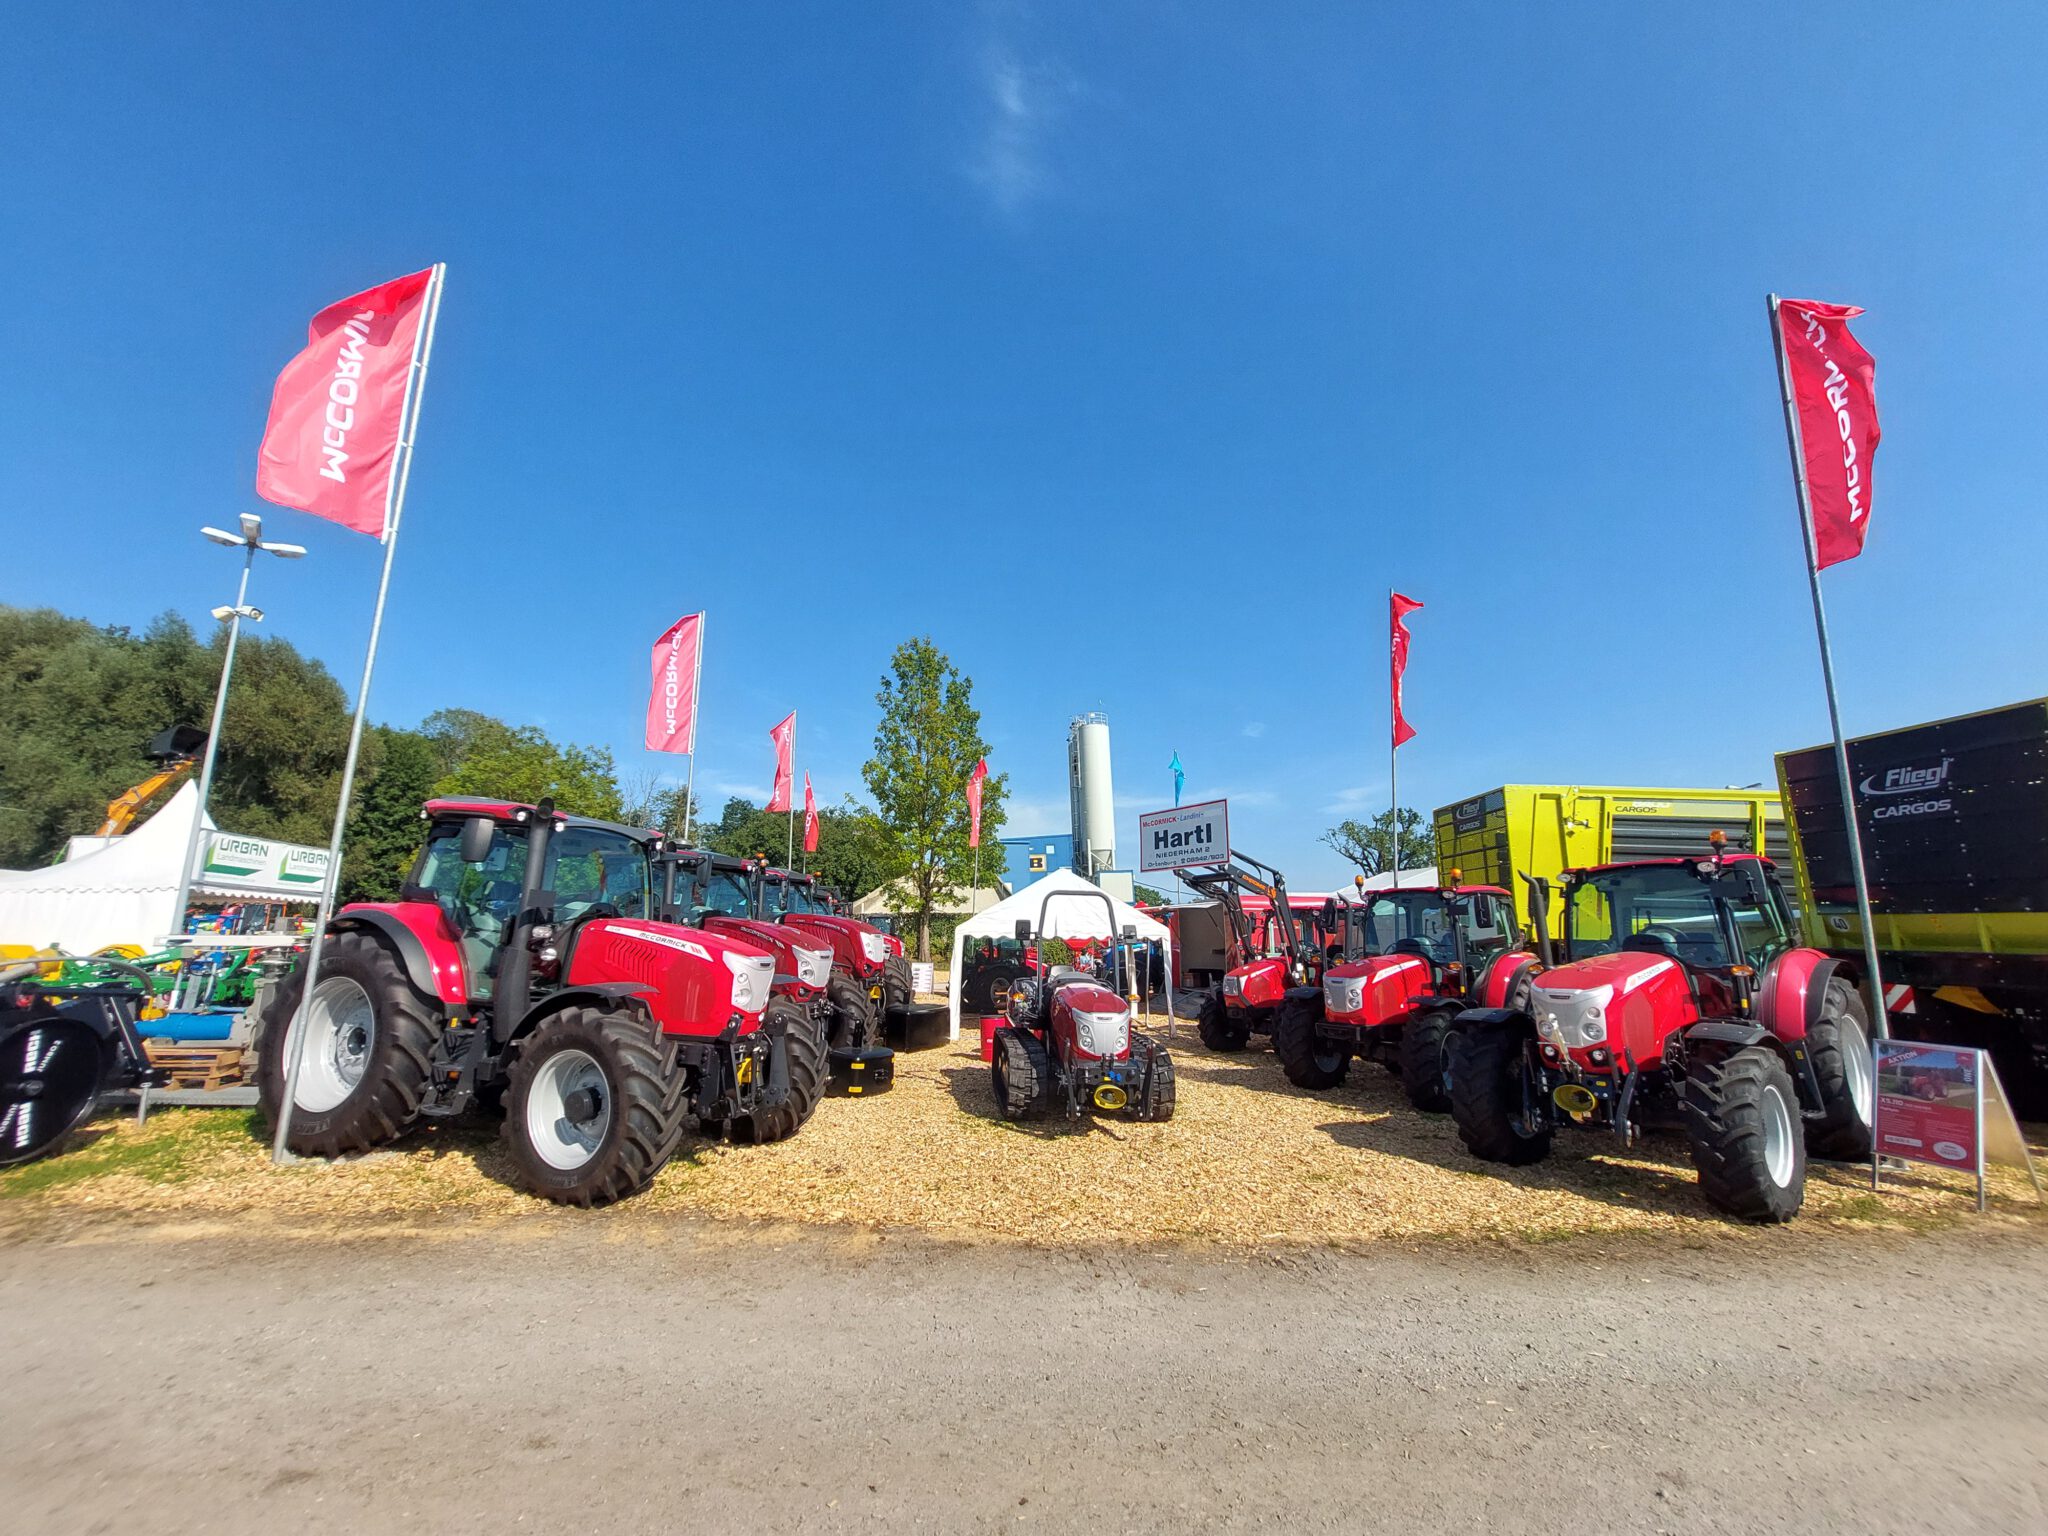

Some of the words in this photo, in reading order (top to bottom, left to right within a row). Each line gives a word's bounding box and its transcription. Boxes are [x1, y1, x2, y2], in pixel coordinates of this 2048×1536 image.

[1884, 758, 1950, 787] Fliegl
[1615, 805, 1658, 814] CARGOS
[1873, 799, 1952, 819] CARGOS
[1154, 823, 1212, 850] Hartl
[220, 838, 270, 858] URBAN
[1155, 847, 1202, 859] NIEDERHAM
[1147, 860, 1177, 868] Ortenburg
[1833, 917, 1849, 931] 40
[1888, 1051, 1918, 1064] AKTION
